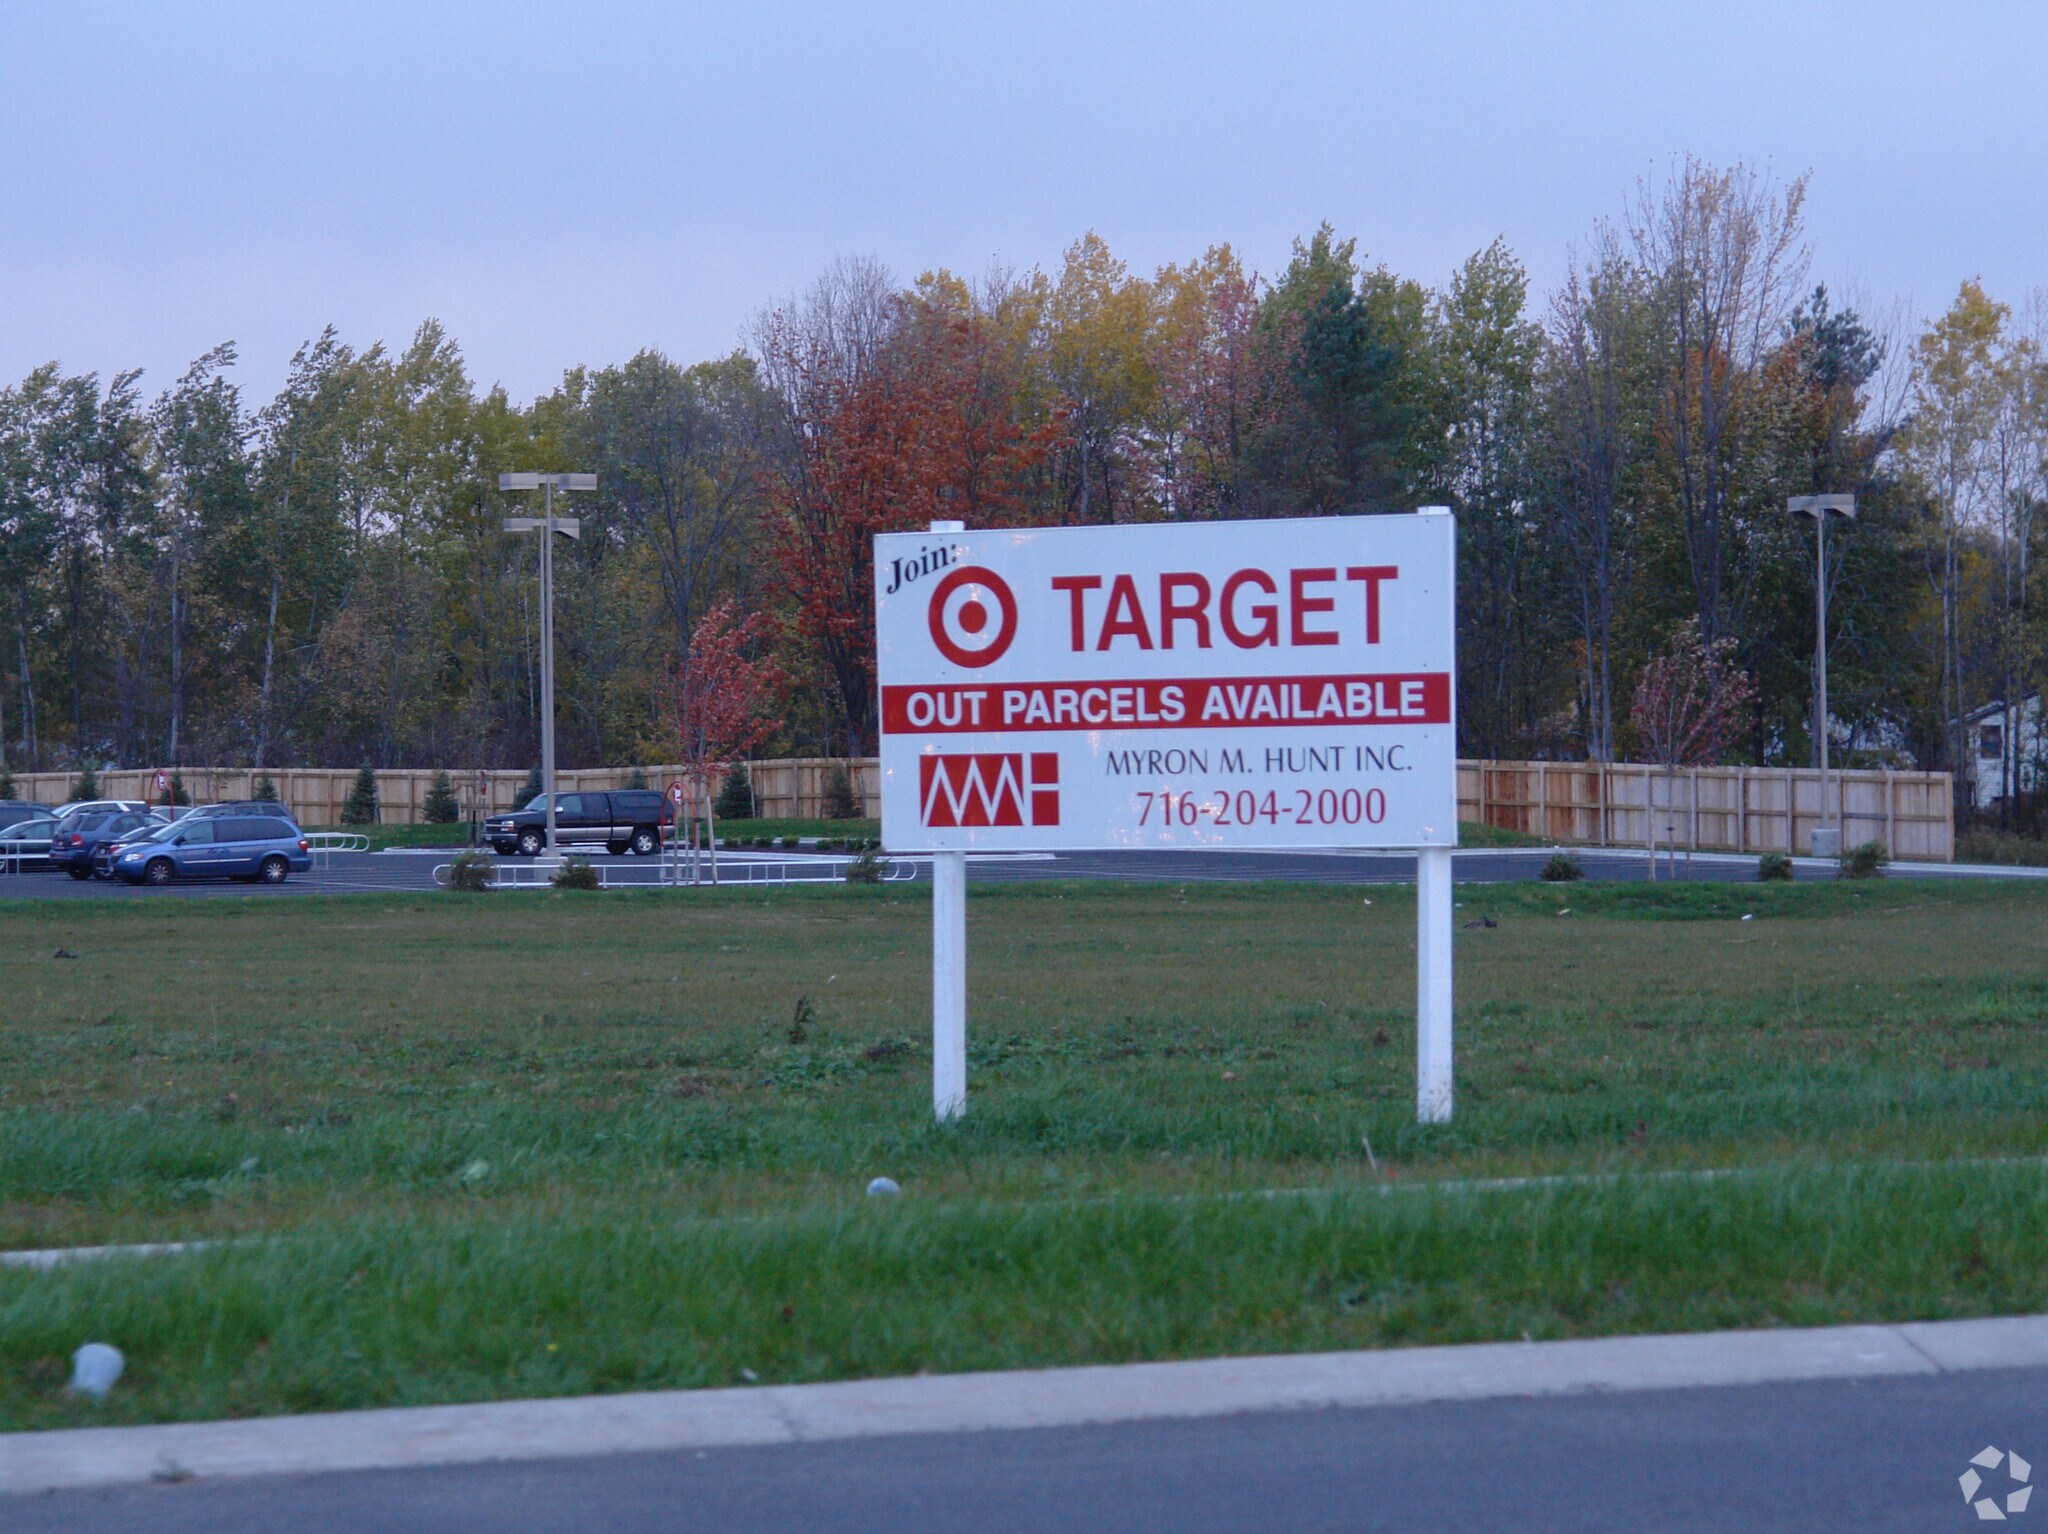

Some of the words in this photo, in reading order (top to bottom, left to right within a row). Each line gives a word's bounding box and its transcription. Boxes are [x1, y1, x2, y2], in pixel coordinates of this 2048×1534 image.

[886, 543, 958, 594] Join:
[1052, 565, 1399, 652] TARGET
[907, 691, 987, 727] OUT
[1004, 686, 1185, 724] PARCELS
[1202, 681, 1425, 720] AVAILABLE
[1106, 749, 1208, 775] MYRON
[1219, 748, 1252, 773] M.
[1265, 746, 1345, 772] HUNT
[1357, 745, 1412, 771] INC.
[1137, 788, 1386, 826] 716-204-2000
